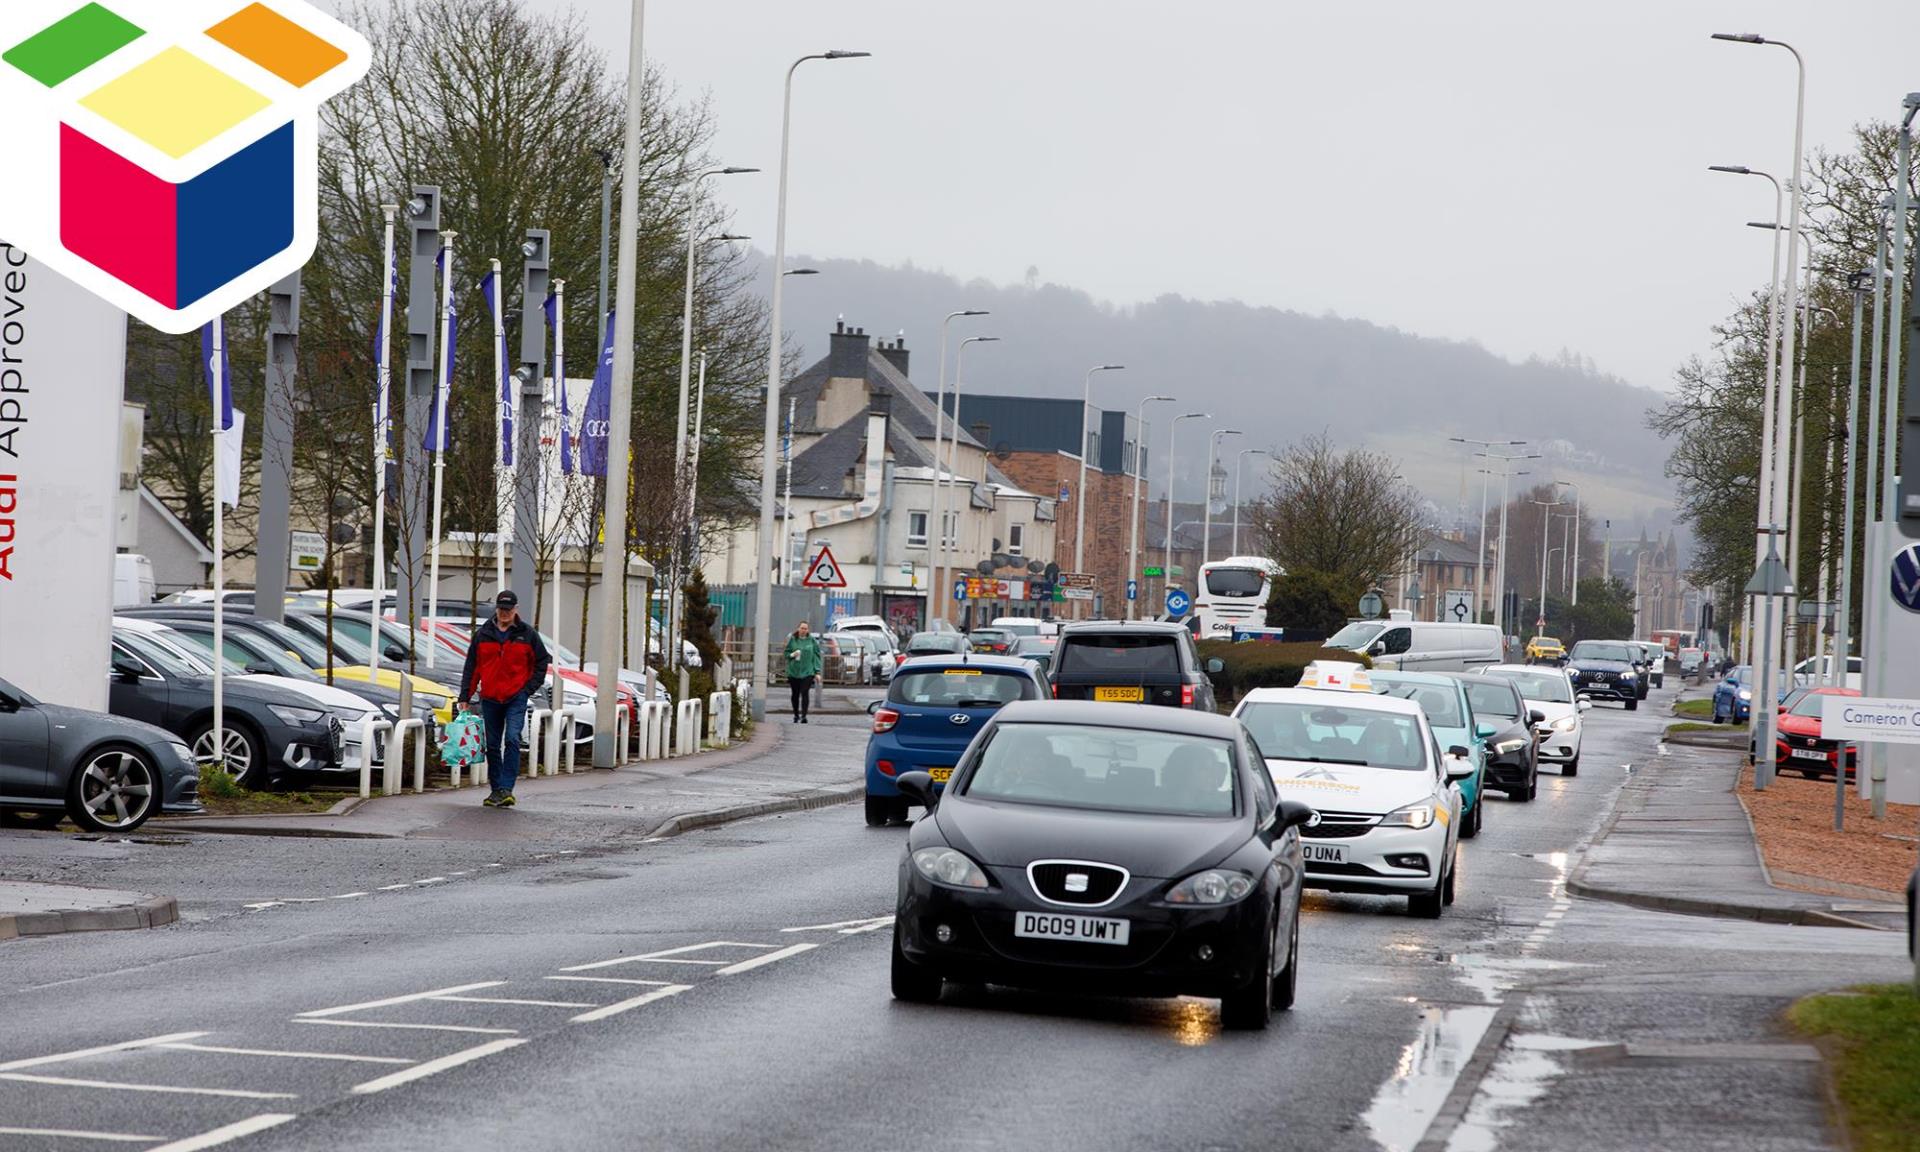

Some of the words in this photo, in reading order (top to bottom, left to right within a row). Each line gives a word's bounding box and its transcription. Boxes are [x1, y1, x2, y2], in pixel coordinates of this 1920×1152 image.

[0, 241, 29, 458] Approved
[1328, 675, 1341, 684] L
[1843, 708, 1907, 726] Cameron
[1315, 846, 1342, 862] UNA
[1024, 915, 1076, 936] DG09
[1081, 919, 1121, 940] UWT
